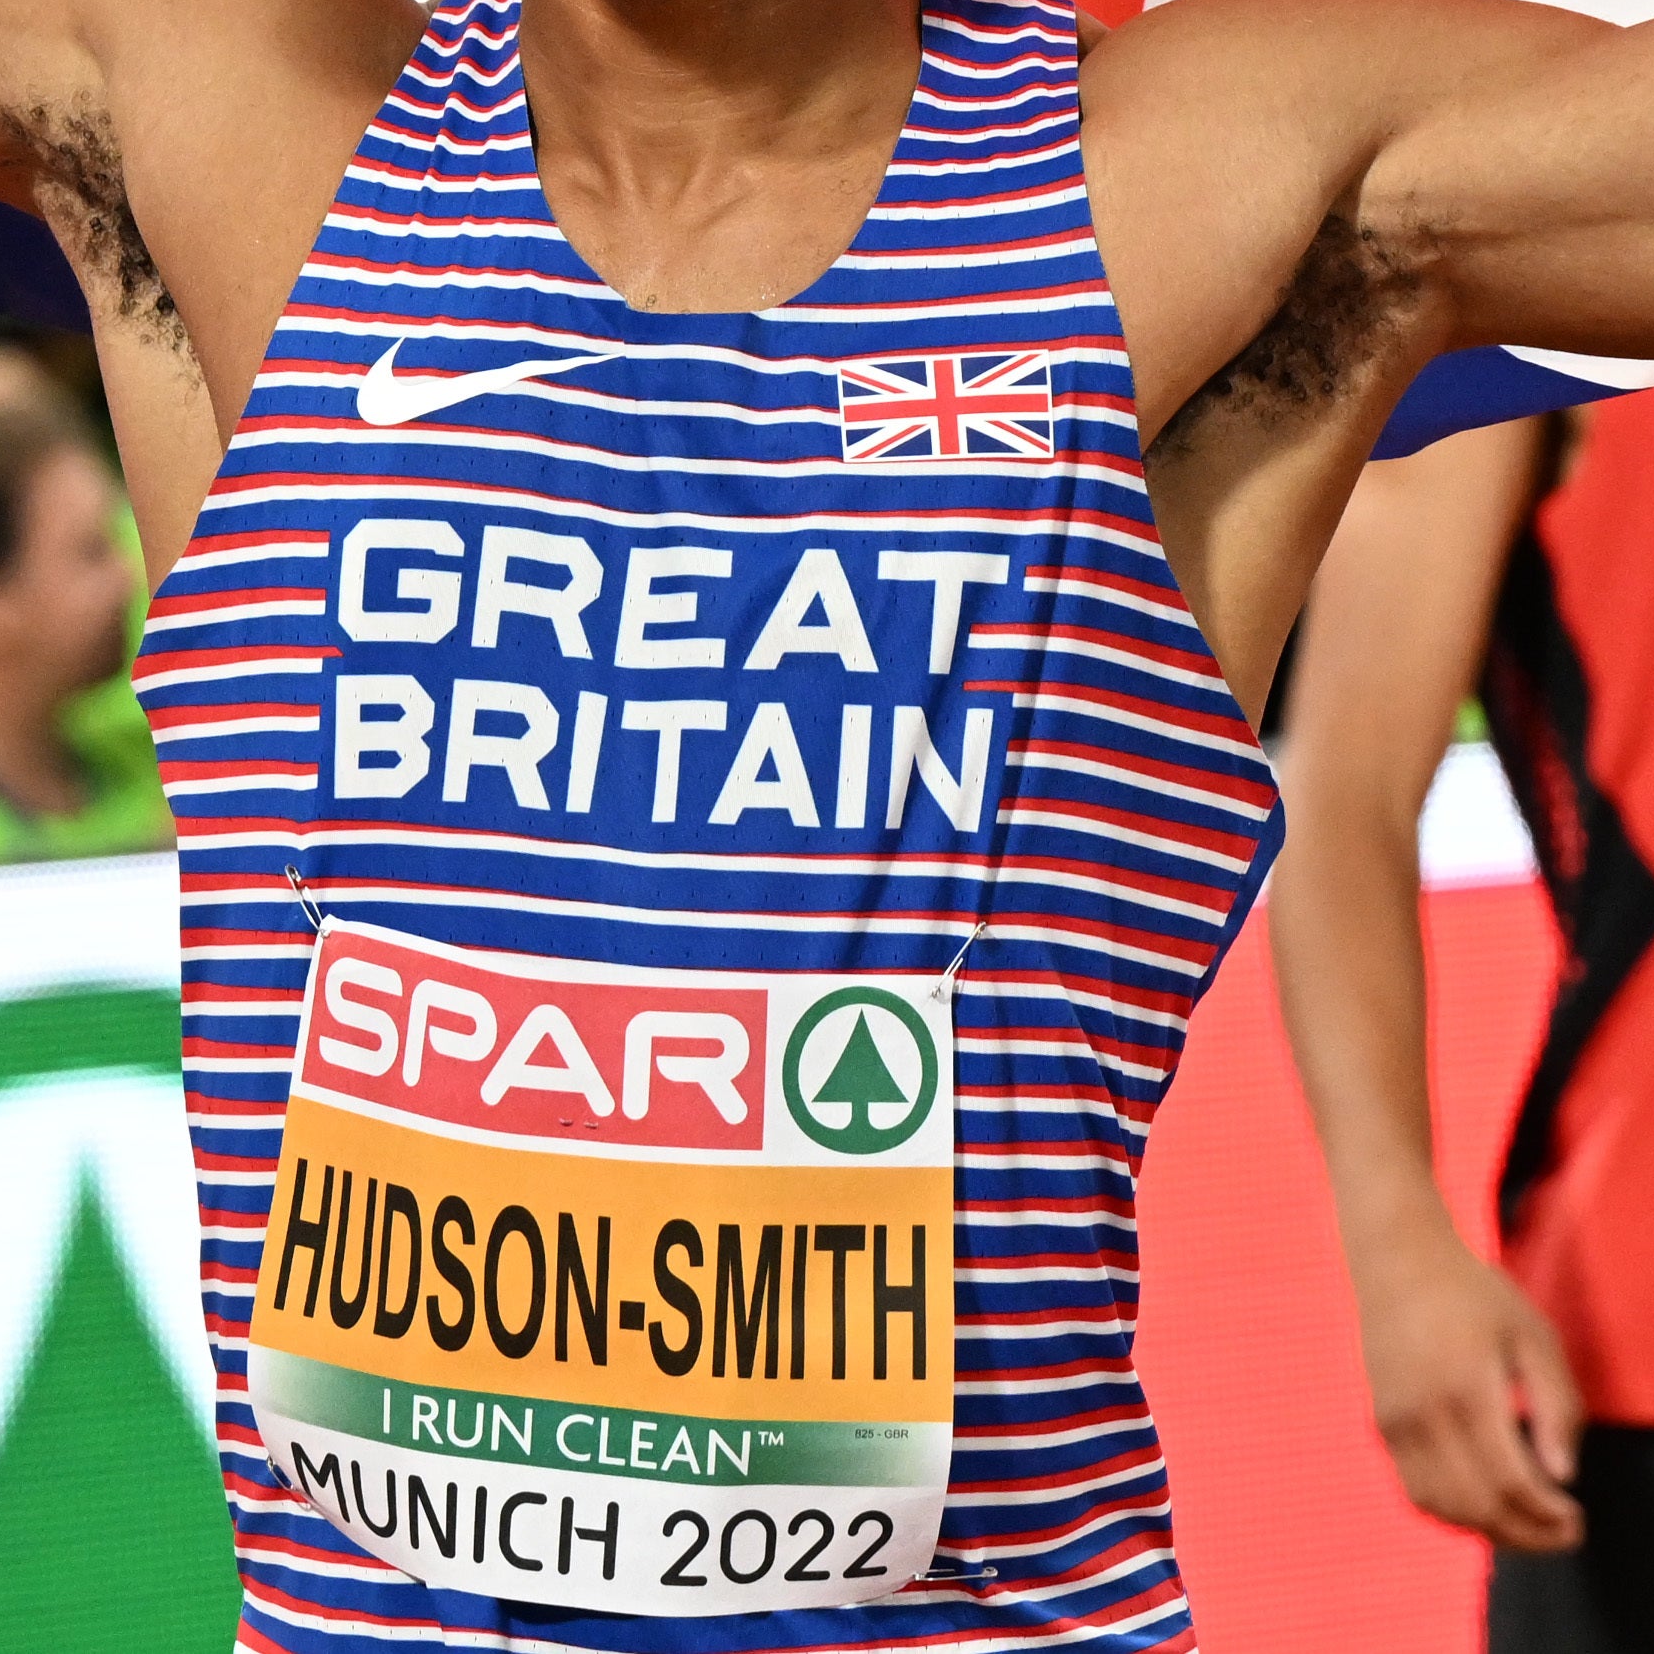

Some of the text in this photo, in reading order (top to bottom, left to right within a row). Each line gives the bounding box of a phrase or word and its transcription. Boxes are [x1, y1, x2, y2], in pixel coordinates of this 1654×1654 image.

[335, 518, 1010, 674] GREAT
[334, 674, 992, 832] BRITAIN
[319, 956, 748, 1125] SPAR
[273, 1157, 928, 1381] HUDSON-SMITH
[382, 1389, 391, 1434] I
[410, 1395, 531, 1453] RUN
[884, 1428, 909, 1440] GBR
[291, 1442, 895, 1588] MUNICH 2022
